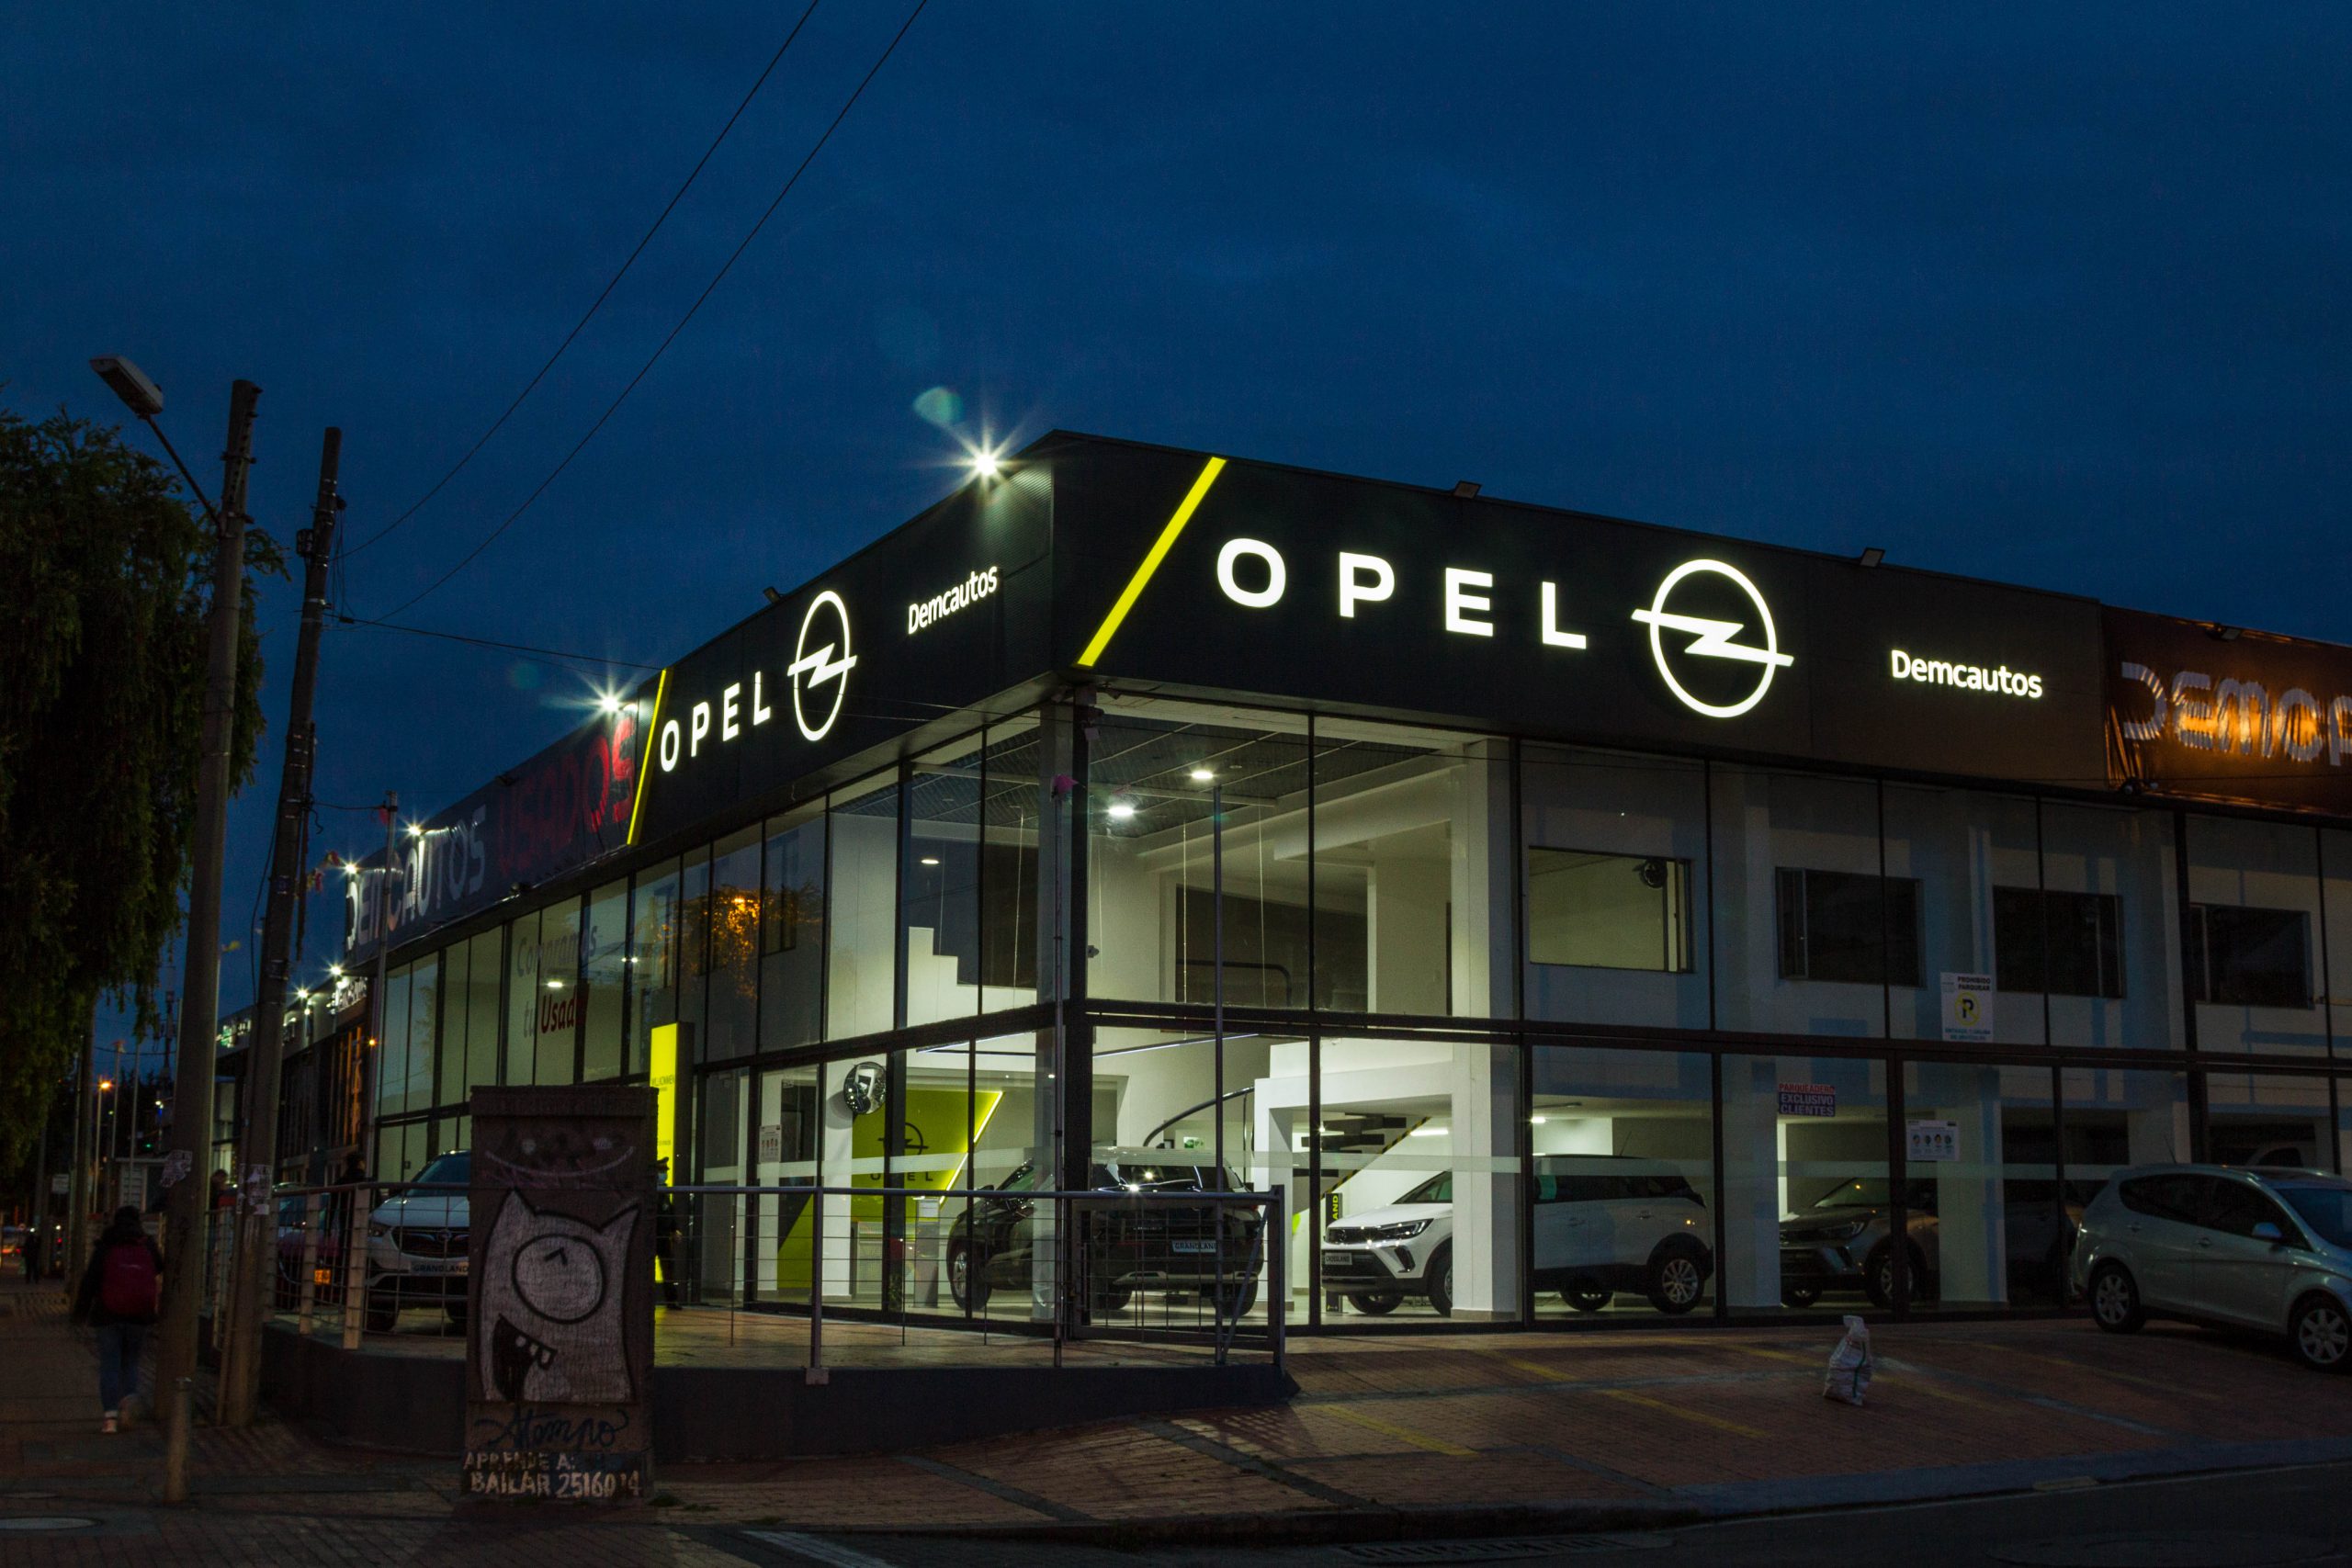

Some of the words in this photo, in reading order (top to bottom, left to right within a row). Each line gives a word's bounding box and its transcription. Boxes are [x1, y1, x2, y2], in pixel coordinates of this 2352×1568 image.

[908, 566, 998, 635] Demcautos
[1217, 538, 1587, 650] OPEL
[1891, 649, 2043, 698] Demcautos
[661, 671, 771, 772] OPEL
[1781, 1093, 1834, 1105] EXCLUSIVO
[1781, 1103, 1834, 1117] CLIENTES
[470, 1470, 551, 1498] BAILAR
